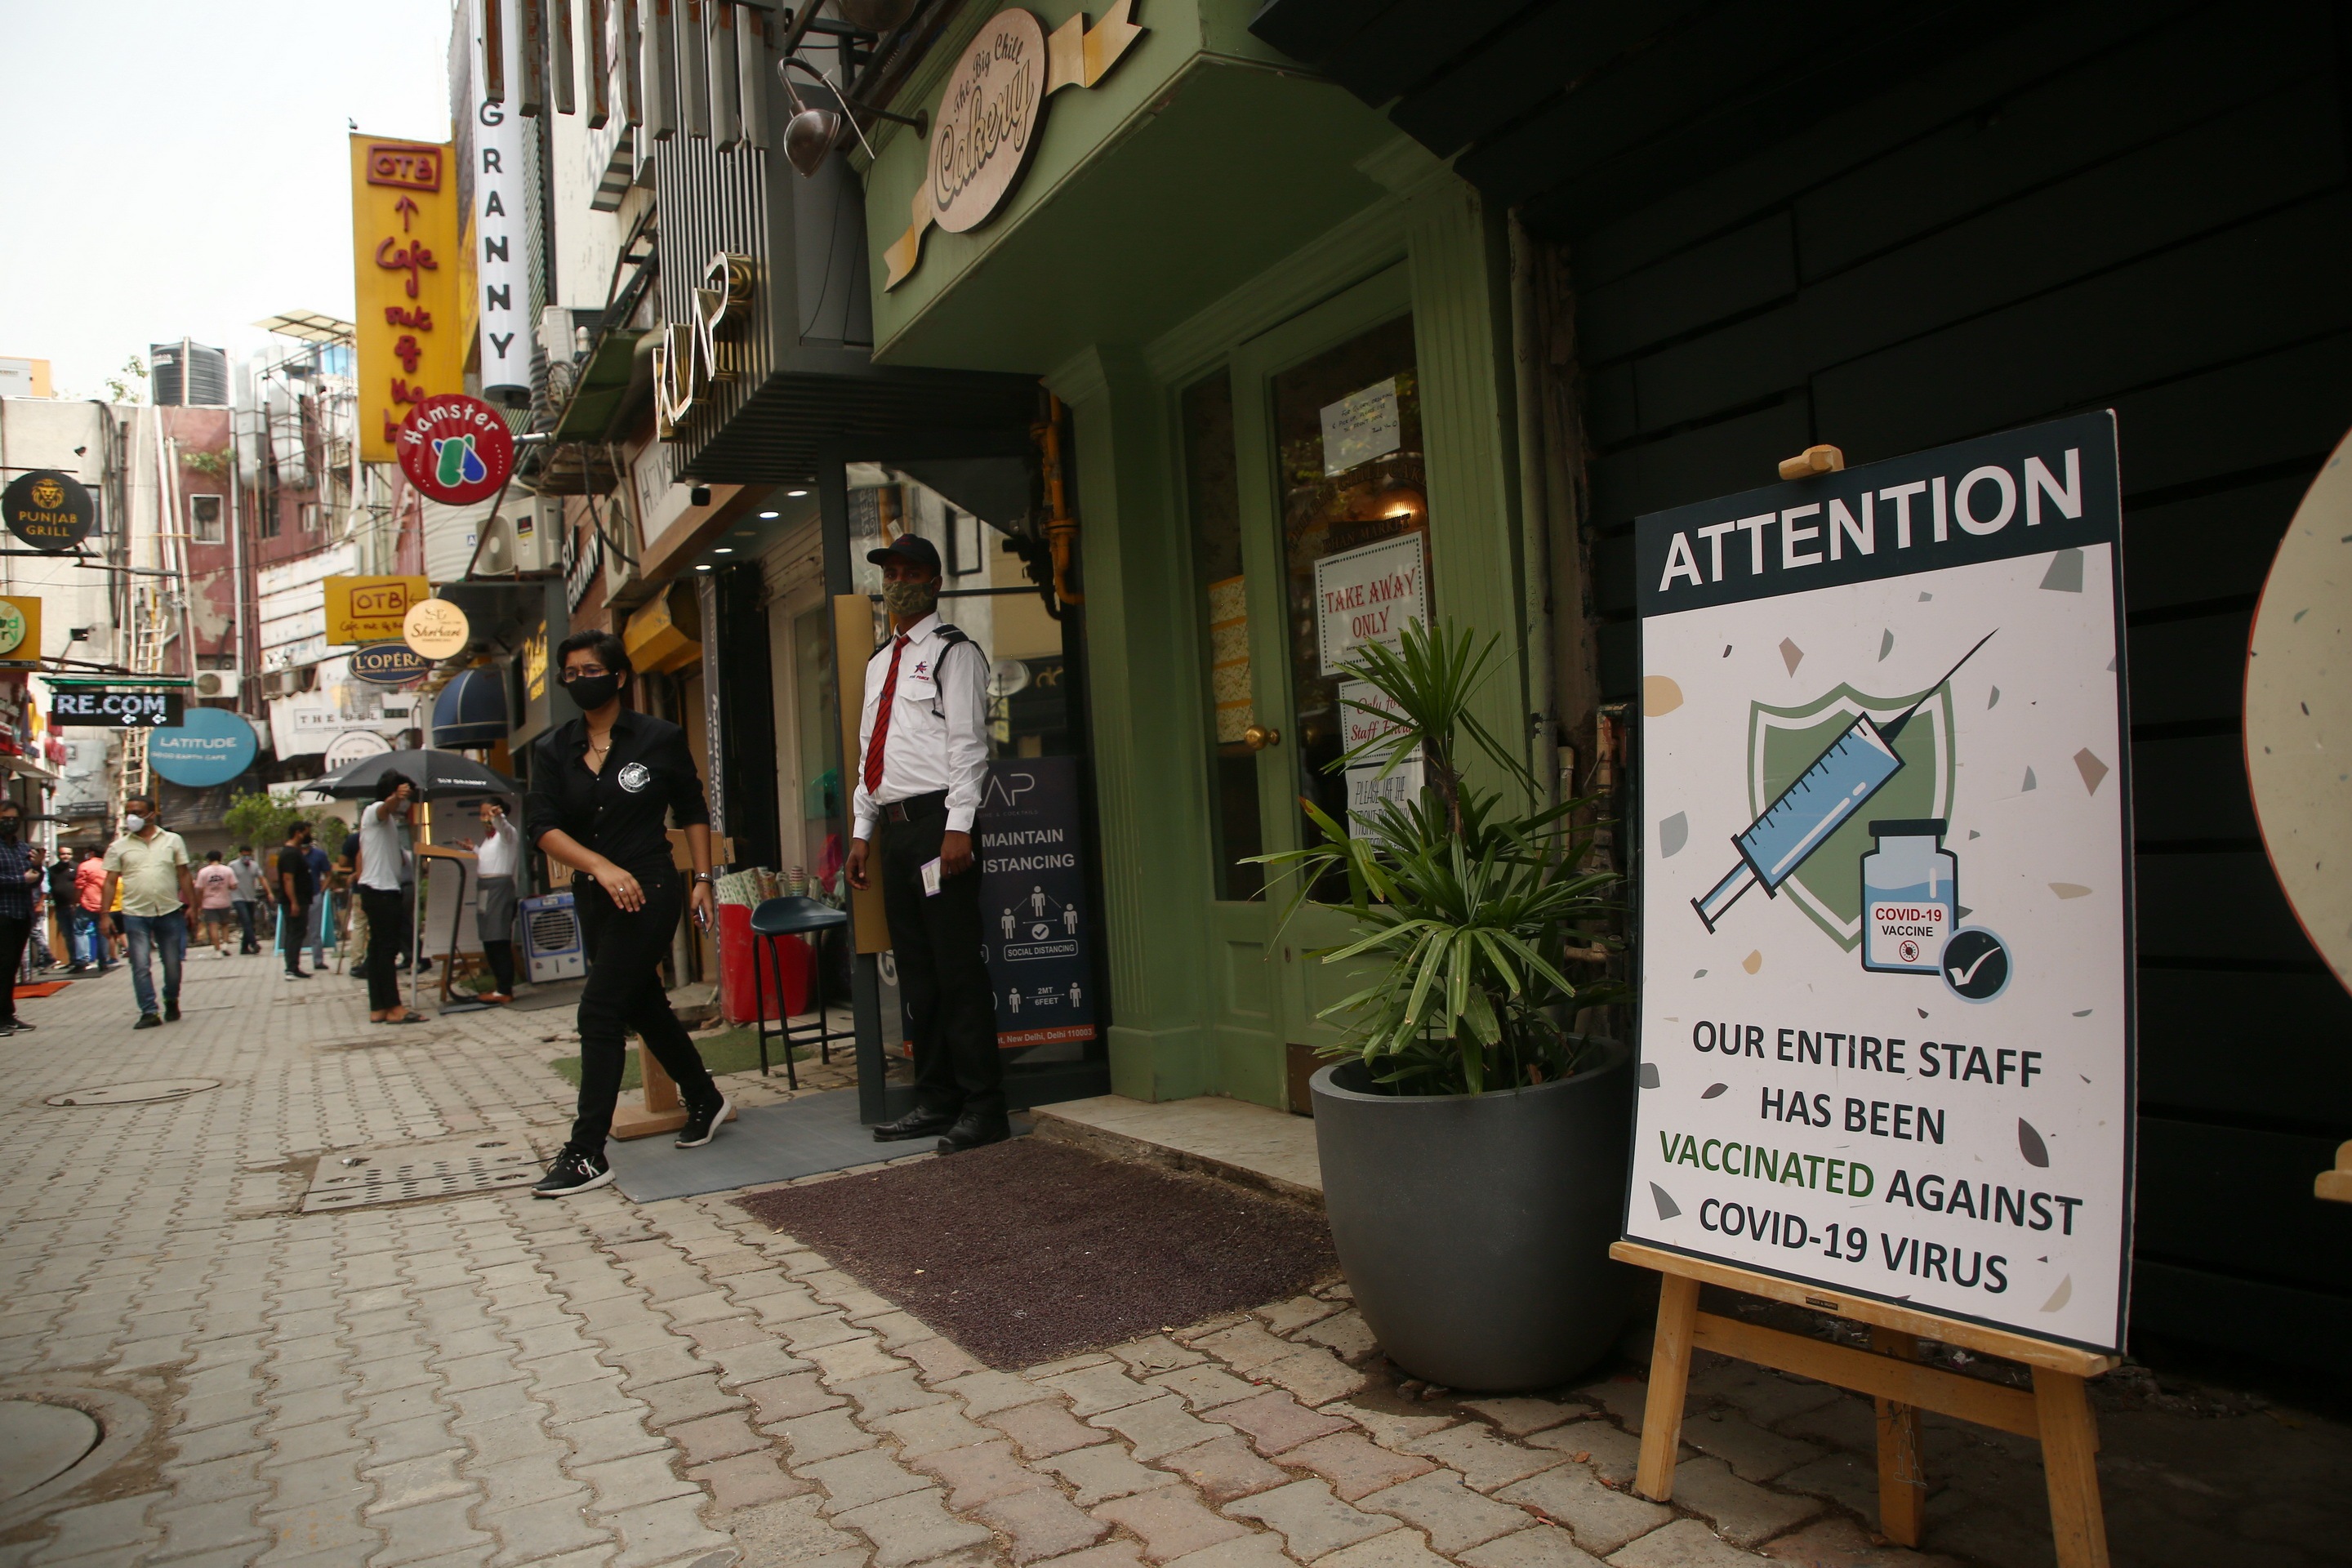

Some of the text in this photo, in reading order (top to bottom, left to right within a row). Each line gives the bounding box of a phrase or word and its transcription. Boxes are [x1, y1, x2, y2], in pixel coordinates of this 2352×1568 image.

[954, 32, 1024, 122] The Big Chill
[935, 59, 1035, 212] Cakery
[375, 154, 432, 180] OTB
[479, 101, 514, 359] GRANNY
[375, 235, 439, 299] Cafe
[385, 305, 433, 331] out
[403, 403, 500, 445] Hamster
[1353, 419, 1369, 428] FRONT
[1338, 463, 1387, 492] CHILL
[19, 510, 78, 525] PUNJAB
[1658, 448, 2082, 593] ATTENTION
[26, 525, 70, 537] GRILL
[1322, 513, 1411, 555] KHAN MARKET
[357, 592, 403, 609] OTB
[1325, 568, 1415, 614] TAKE AWAY
[1352, 605, 1390, 639] ONLY
[356, 652, 425, 670] L'OPÉRA
[300, 714, 334, 723] THE
[1351, 720, 1379, 742] Staff
[159, 737, 237, 748] LATITUDE
[1356, 778, 1379, 805] PLEASE
[1396, 776, 1405, 801] THE
[982, 828, 1064, 848] MAINTAIN
[982, 853, 1075, 874] ISTANCING
[1875, 908, 1942, 922] COVID-19
[1882, 925, 1933, 937] VACCINE
[1008, 944, 1075, 957] SOCIAL DISTANCING
[1035, 997, 1059, 1006] 6FEET
[1038, 987, 1054, 995] 2MT
[1007, 1034, 1024, 1044] New
[1024, 1032, 1046, 1041] Delhi,
[1047, 1030, 1066, 1040] Delhi
[1067, 1028, 1092, 1037] 110003
[1693, 1021, 2042, 1088] OUR ENTIRE STAFF
[1761, 1086, 1945, 1145] HAS BEEN
[1659, 1130, 2083, 1236] VACCINATED AGAINST
[1699, 1198, 2008, 1294] COVID-19 VIRUS
